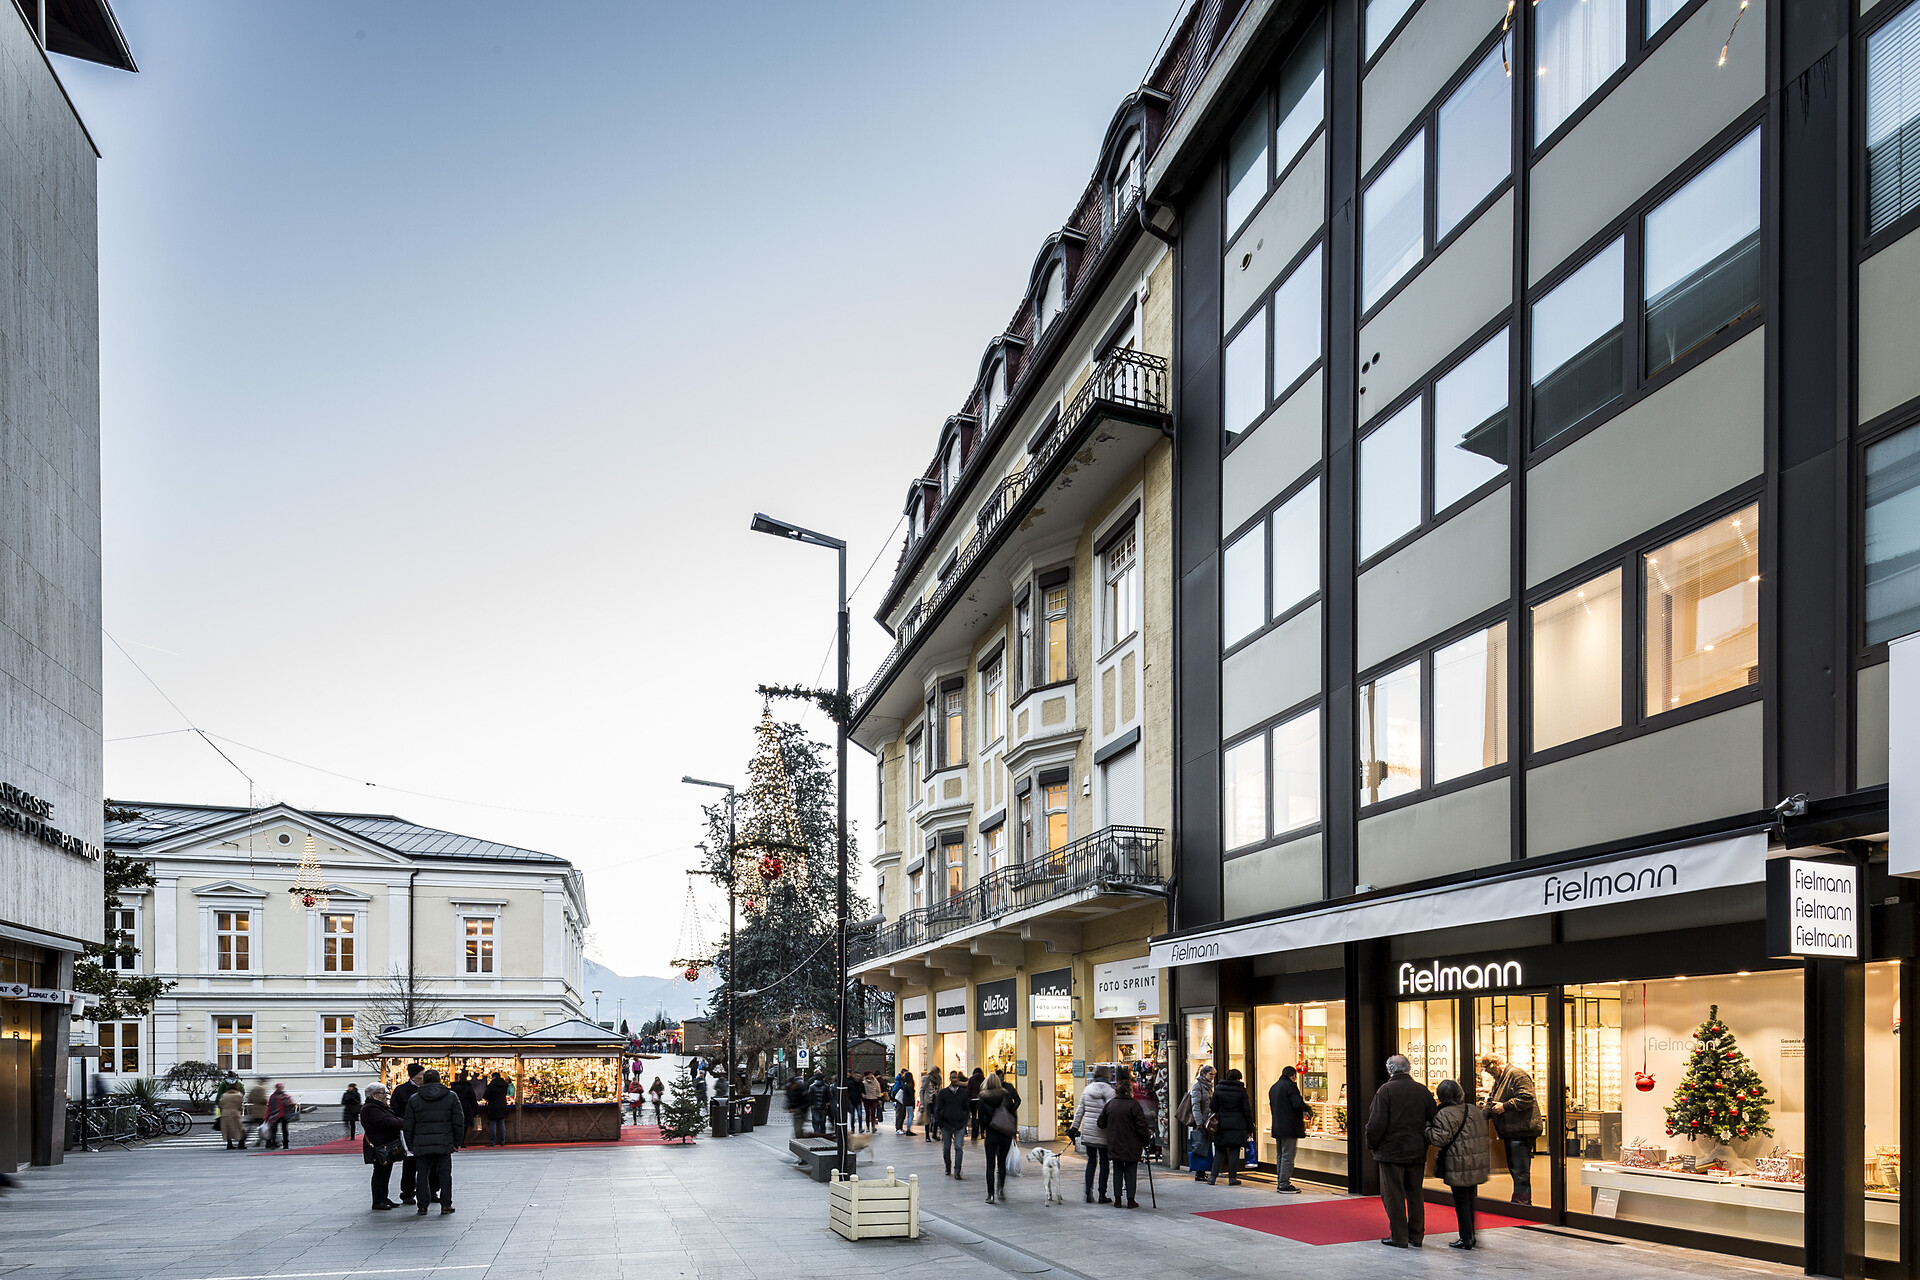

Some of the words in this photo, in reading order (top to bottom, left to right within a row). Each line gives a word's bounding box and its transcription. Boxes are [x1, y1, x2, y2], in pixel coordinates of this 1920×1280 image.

[43, 823, 101, 861] RISPARMIO
[1544, 864, 1677, 905] fielmann
[1795, 868, 1852, 893] fielmann
[1795, 897, 1852, 921] fielmann
[1796, 925, 1852, 949] fielmann
[1171, 942, 1219, 961] fielmann
[1098, 980, 1120, 992] FOTO
[1123, 976, 1156, 990] SPRINT
[1399, 960, 1522, 994] fielmann
[1648, 1036, 1715, 1051] fielmann
